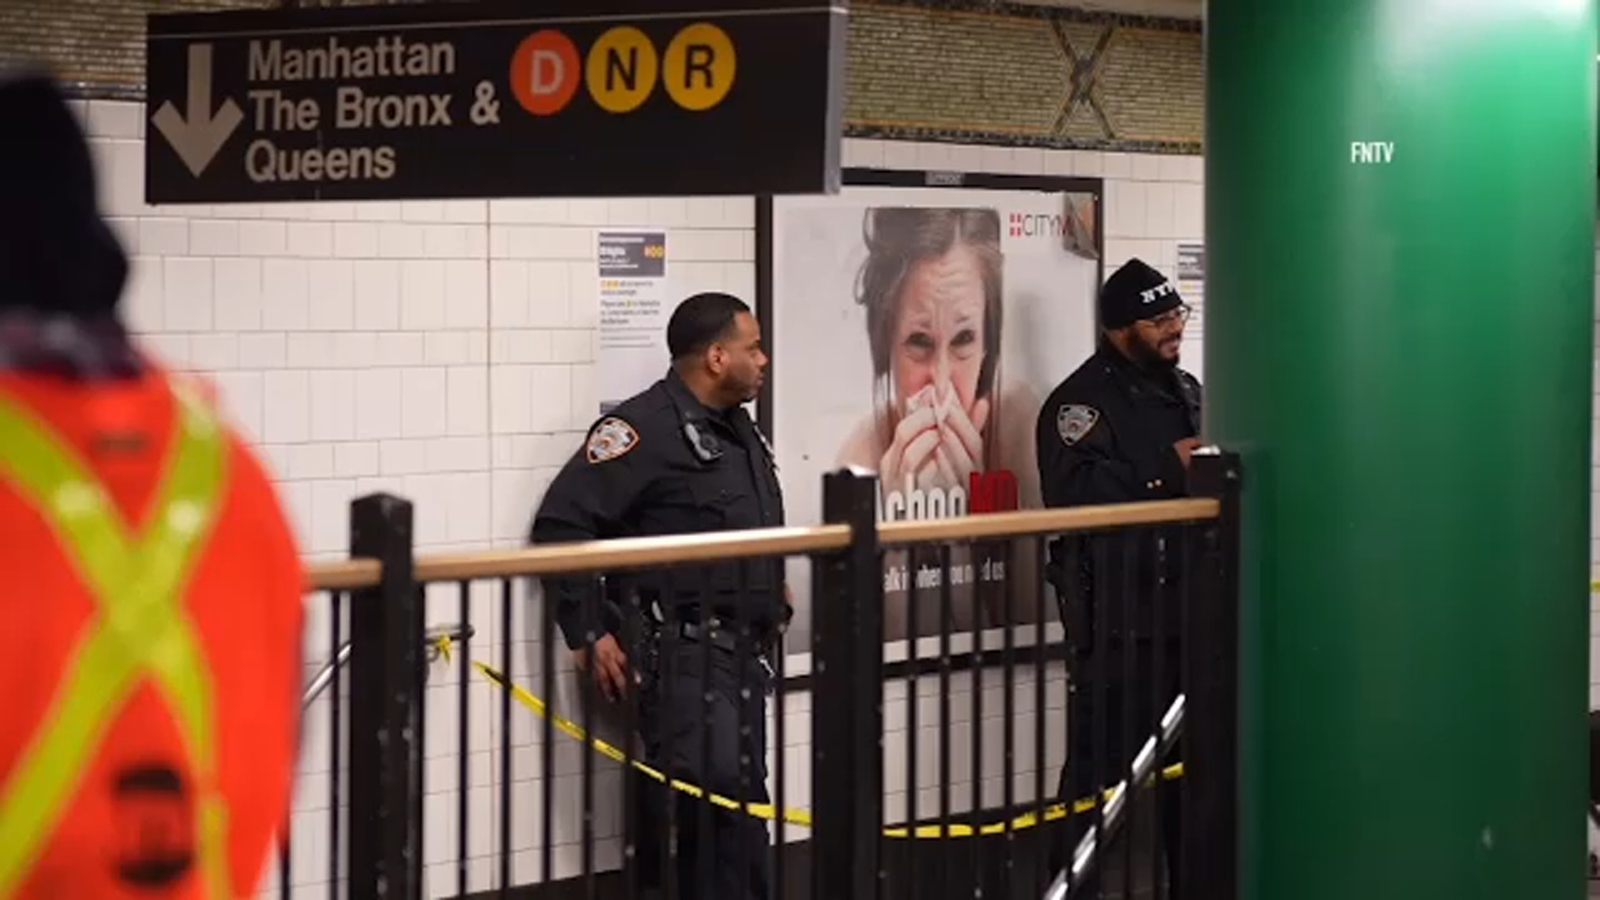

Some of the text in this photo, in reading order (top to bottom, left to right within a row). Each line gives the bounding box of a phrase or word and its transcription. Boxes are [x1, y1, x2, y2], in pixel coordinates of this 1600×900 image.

[248, 36, 456, 82] Manhattan
[530, 44, 715, 95] D N R
[248, 80, 501, 132] The Bronx &
[245, 139, 397, 183] Queens
[1022, 213, 1078, 237] CITYM
